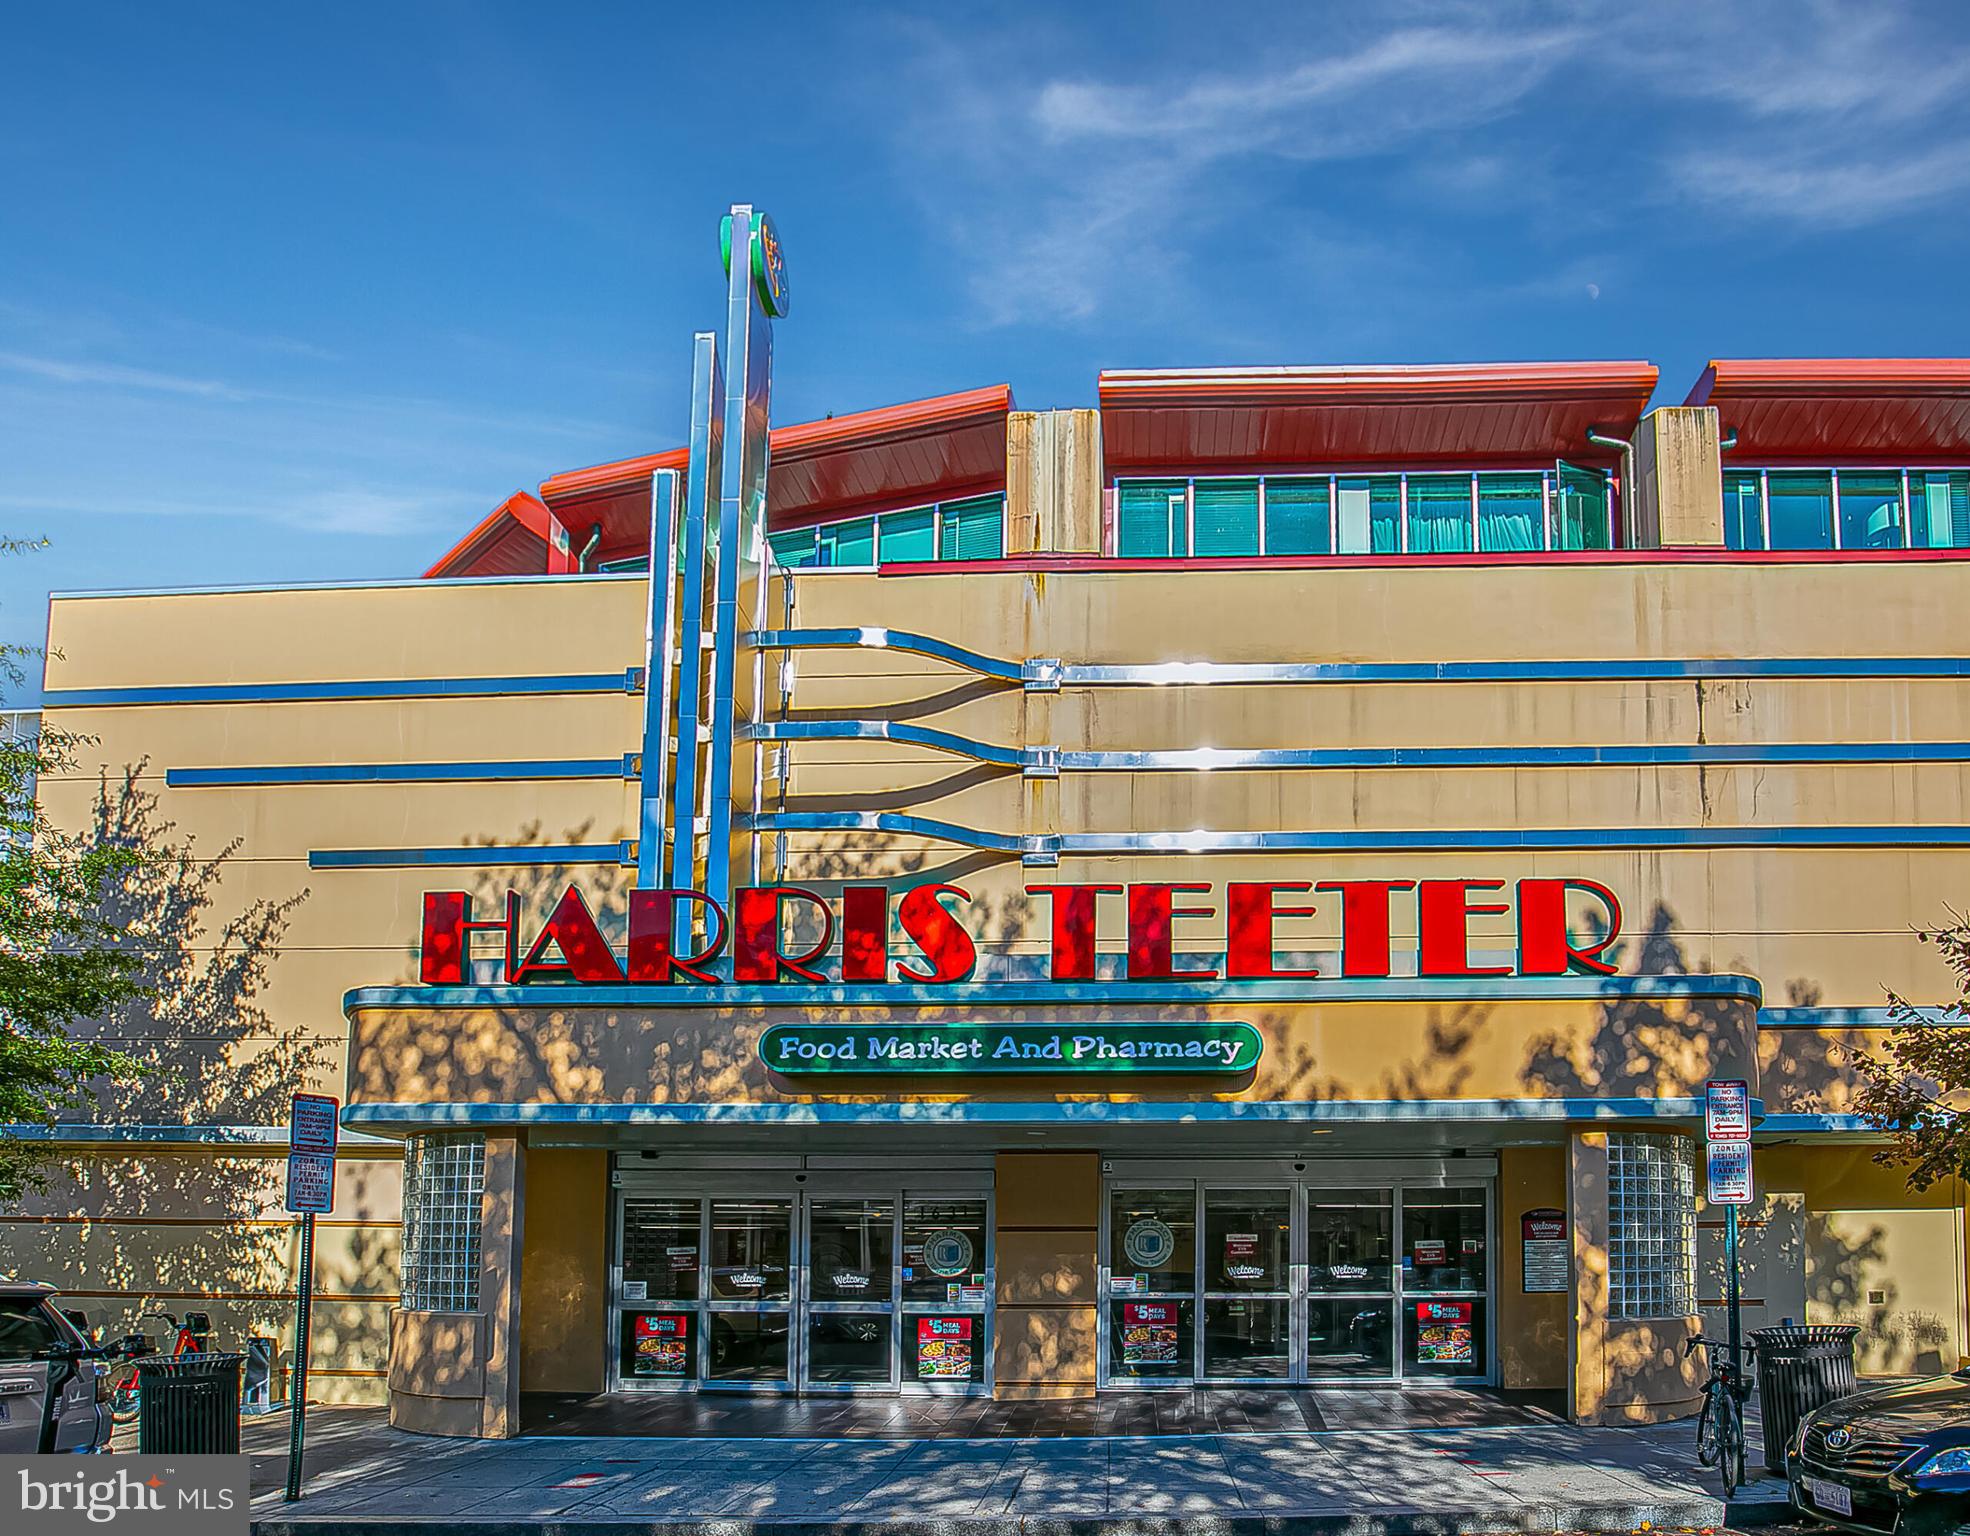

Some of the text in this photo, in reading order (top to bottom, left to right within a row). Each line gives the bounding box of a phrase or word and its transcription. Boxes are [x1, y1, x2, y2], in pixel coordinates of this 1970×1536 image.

[420, 878, 1620, 984] HARRIS TEETER
[779, 1036, 1244, 1064] Food Market And Pharmacy
[297, 1109, 333, 1118] PARKING
[294, 1163, 329, 1172] RESIDENT
[1104, 1162, 1111, 1170] 2
[1713, 1167, 1746, 1175] PARKING
[293, 1177, 329, 1185] PARKING
[1530, 1220, 1563, 1232] Welcome
[1226, 1264, 1265, 1276] Welcome
[1330, 1264, 1368, 1276] Welcome
[730, 1272, 767, 1284] Welcome
[832, 1273, 870, 1285] Welcome
[1134, 1304, 1149, 1319] $5
[1428, 1303, 1443, 1319] $5
[645, 1316, 659, 1331] $5
[928, 1319, 943, 1334] $5
